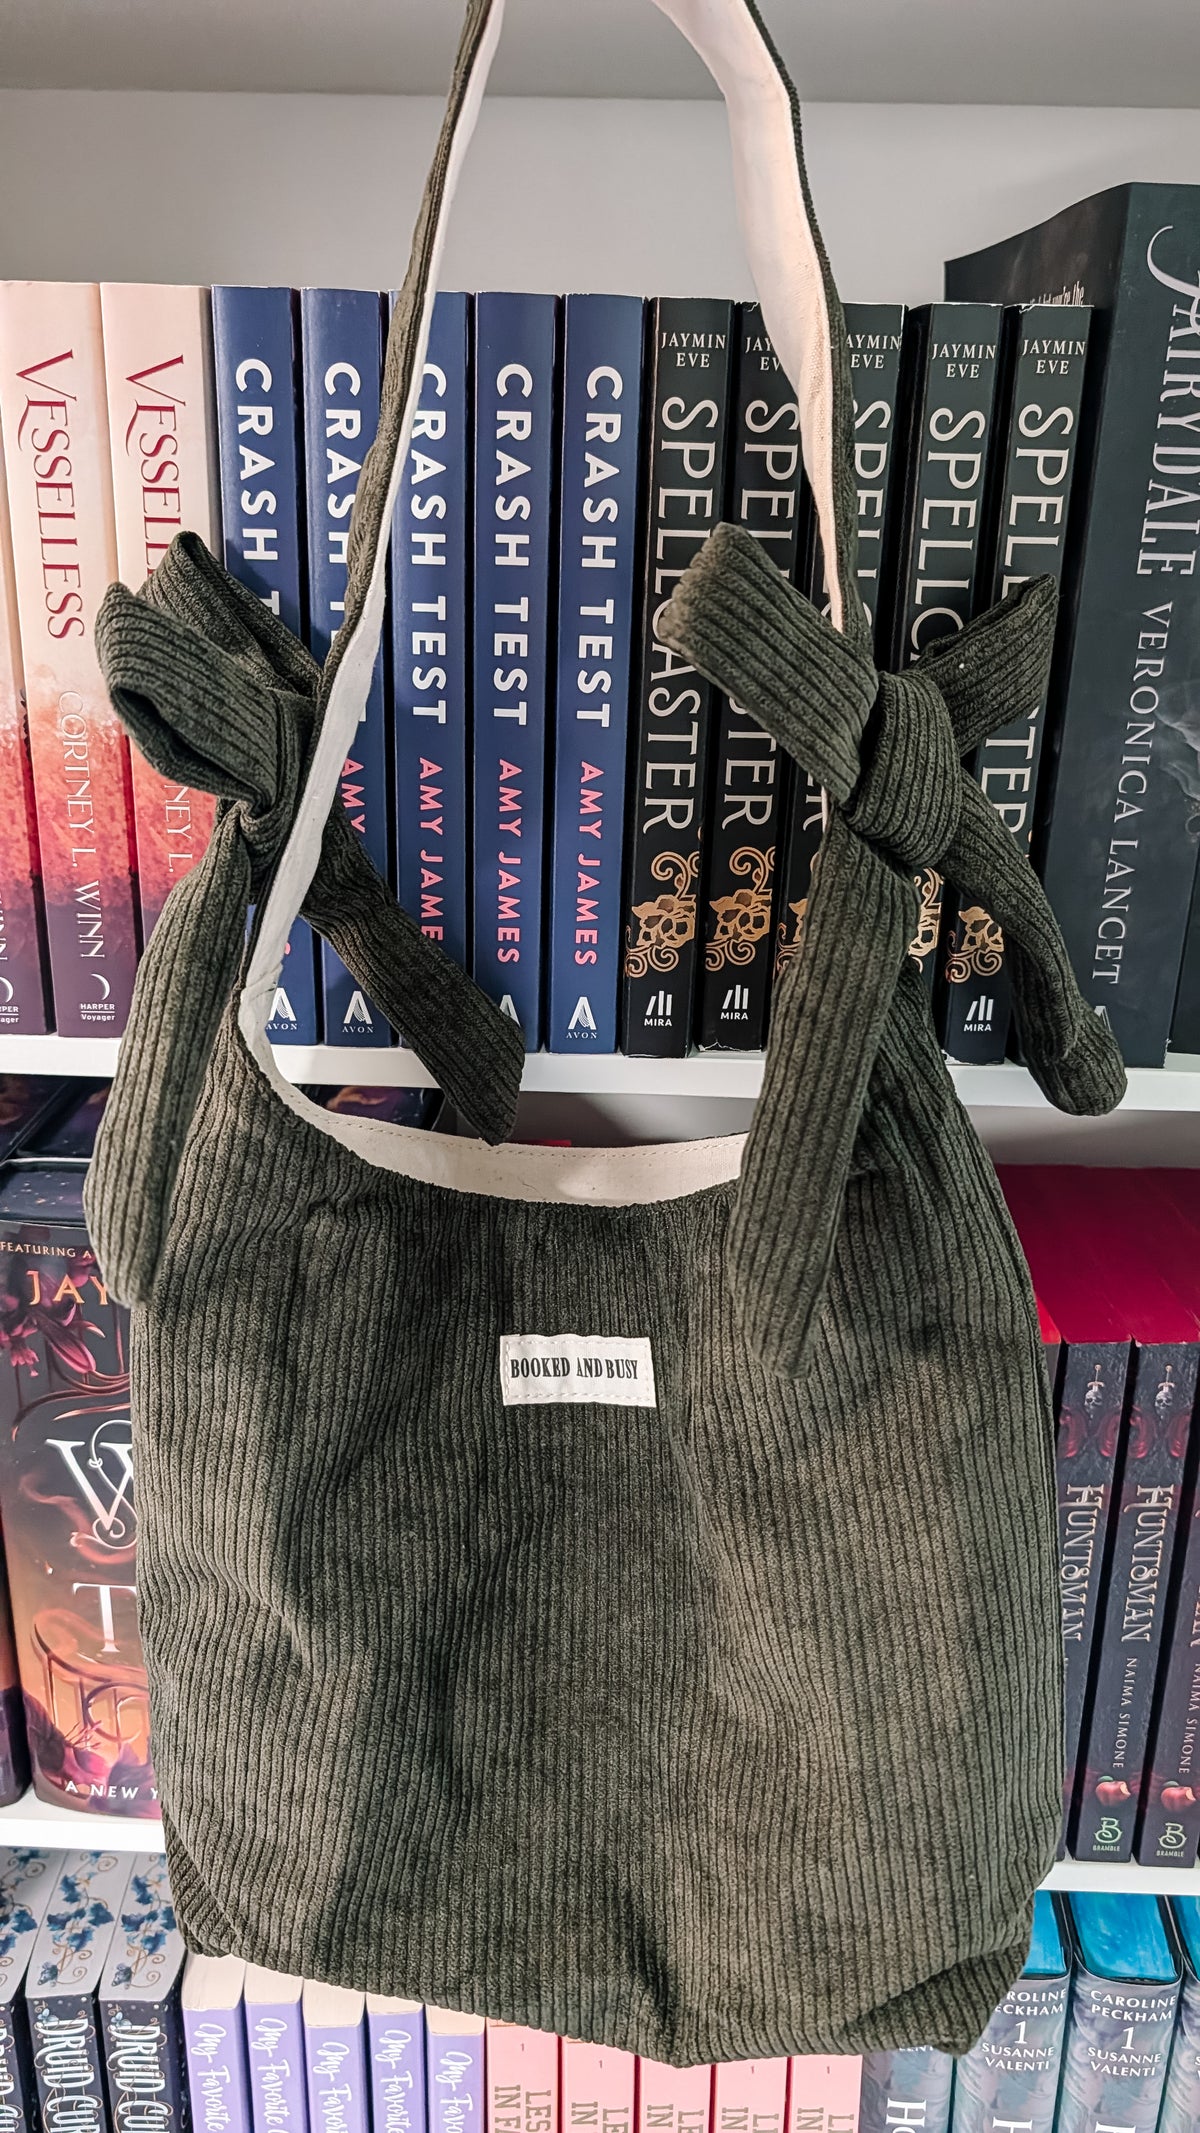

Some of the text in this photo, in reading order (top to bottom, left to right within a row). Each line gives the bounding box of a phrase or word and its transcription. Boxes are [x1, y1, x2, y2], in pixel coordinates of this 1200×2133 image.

[661, 332, 726, 350] JAYMIN
[745, 336, 773, 353] JAY
[845, 334, 900, 350] AYMIN
[932, 343, 996, 360] JAYMIN
[1022, 339, 1086, 356] JAYMIN
[675, 352, 711, 369] EVE
[760, 355, 783, 371] EV
[850, 353, 885, 370] EVE
[946, 363, 980, 379] EVE
[1036, 359, 1070, 375] EVE
[126, 354, 186, 576] VESSELL
[235, 358, 279, 561] CRASH
[324, 361, 362, 564] CRASH
[16, 349, 85, 638] VESSELLESS
[411, 363, 447, 725] CRASH TEST
[493, 363, 533, 726] CRASH TEST
[576, 365, 623, 728] CRASH TEST
[341, 757, 365, 833] AMY
[1092, 601, 1174, 985] VERONICA LANCET
[59, 690, 105, 958] CORTNEY L. WINN
[419, 757, 444, 941] AMY JAME
[497, 758, 523, 964] AMY JAMES
[574, 761, 605, 966] AMY JAMES
[80, 1003, 115, 1011] HARPER
[81, 1013, 115, 1022] Voyager
[720, 1012, 749, 1020] MIRA
[0, 1016, 20, 1024] ager
[266, 1023, 298, 1031] AVON
[342, 1026, 374, 1034] AVON
[644, 1018, 673, 1027] MIRA
[963, 1023, 992, 1032] MIRA
[0, 1241, 76, 1258] FEATURING
[26, 1270, 109, 1306] JAY
[510, 1356, 638, 1380] BOOKED AND BUSY
[1059, 1484, 1105, 1642] HUNTSMAN
[1121, 1484, 1175, 1643] HUNTSMAN
[1112, 1657, 1138, 1769] NAIMA SIMONE
[1178, 1718, 1198, 1774] SIMONE
[65, 1780, 78, 1793] A
[90, 1784, 140, 1799] NEW
[1006, 1987, 1067, 2001] ROLINE
[1090, 1989, 1177, 2008] CAROLINE
[995, 2002, 1064, 2016] ECKHAM
[1091, 2005, 1173, 2022] PECKHAM
[35, 2019, 95, 2088] DRUID
[107, 2025, 166, 2093] DRUID
[374, 2029, 413, 2069] My
[981, 2042, 1055, 2057] SUSANNE
[1087, 2046, 1162, 2064] SUSANNE
[250, 2017, 291, 2125] My Favorite
[313, 2041, 350, 2082] My
[435, 2051, 473, 2092] My
[984, 2056, 1050, 2071] VALENTI
[1090, 2060, 1156, 2077] VALENTI
[190, 2022, 231, 2132] My Favorite
[494, 2084, 521, 2109] IN
[571, 2101, 599, 2126] IN
[646, 2103, 674, 2128] IN
[721, 2106, 749, 2131] IN
[796, 2107, 824, 2131] IN
